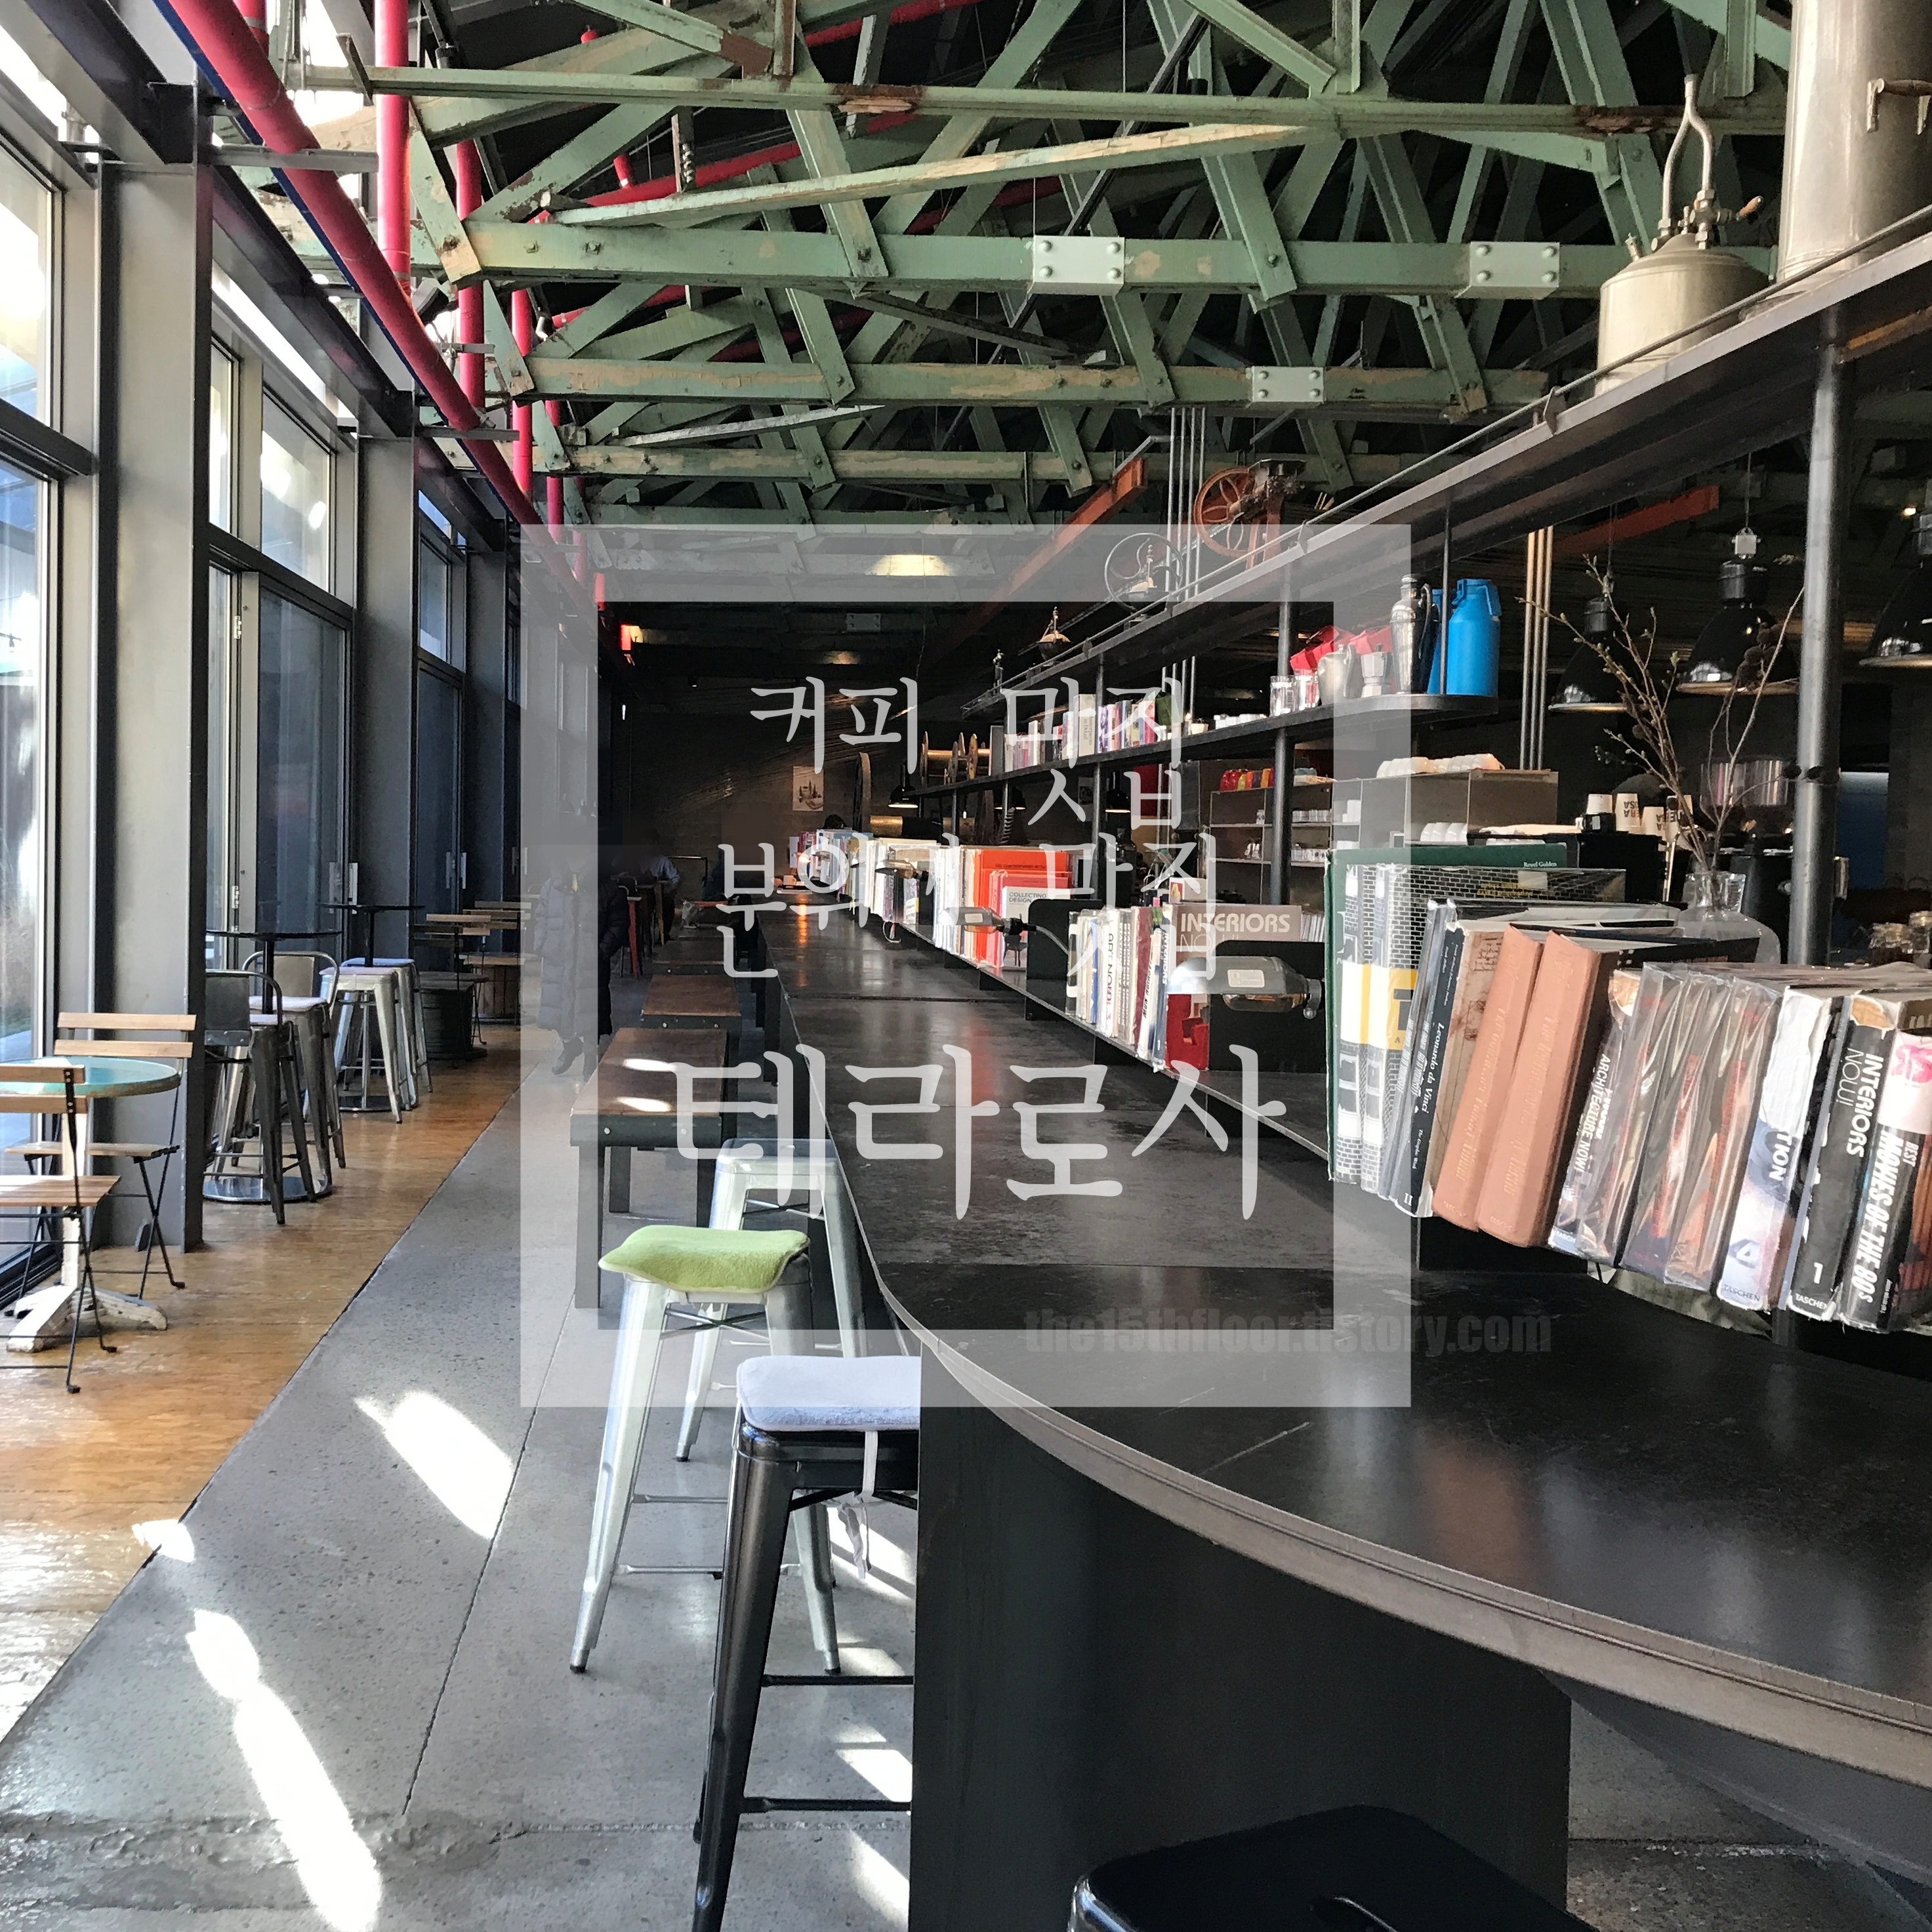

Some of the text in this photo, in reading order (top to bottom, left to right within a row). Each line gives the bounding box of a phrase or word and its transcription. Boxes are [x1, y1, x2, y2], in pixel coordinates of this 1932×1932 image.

[1181, 913, 1290, 933] INTERIORS
[1420, 1022, 1445, 1113] Leonardo da Vinci
[1836, 1047, 1864, 1107] NOW!
[1572, 1054, 1611, 1172] ARCHITECTURE NOW!
[1846, 1053, 1884, 1158] INTERIORS
[1868, 1130, 1904, 1206] MOVIES
[1902, 1141, 1920, 1168] BEST
[1863, 1203, 1889, 1233] OF
[1555, 1229, 1576, 1243] TASCH
[1856, 1229, 1885, 1269] THE
[1813, 1262, 1824, 1285] 1
[1723, 1283, 1761, 1302] TASCHEN
